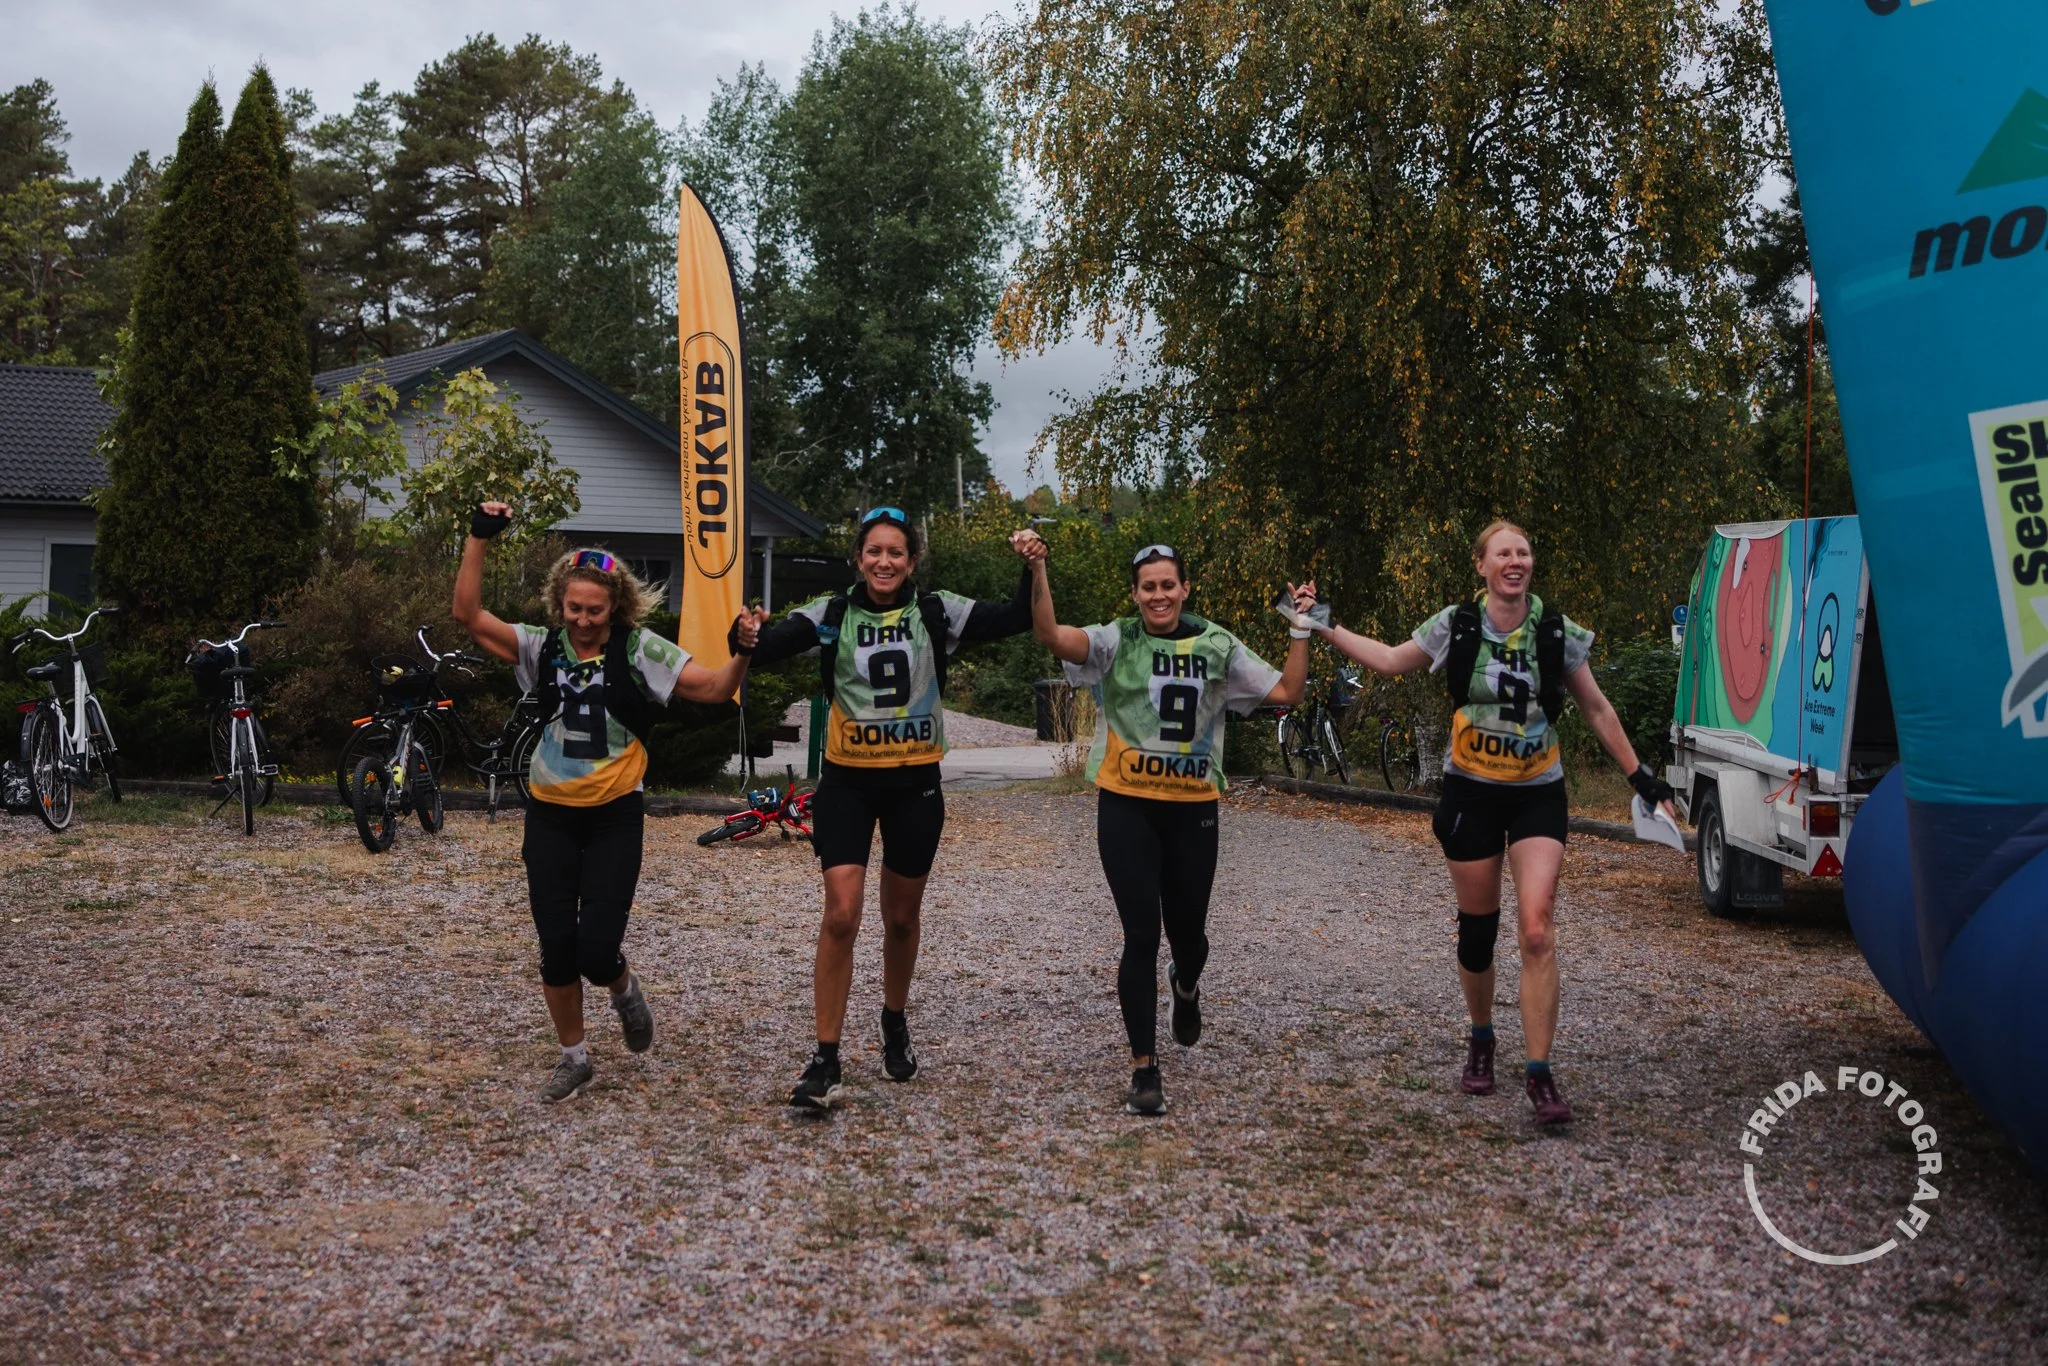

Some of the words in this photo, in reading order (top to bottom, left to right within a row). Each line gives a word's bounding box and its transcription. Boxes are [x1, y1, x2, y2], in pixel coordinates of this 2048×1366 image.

[1908, 205, 2048, 280] mo
[868, 650, 911, 709] 9
[1152, 648, 1208, 681] ÖAR
[1160, 684, 1199, 743] 9
[1498, 671, 1530, 726] 9
[850, 720, 931, 746] JOKAB
[1130, 754, 1209, 779] JOKAB
